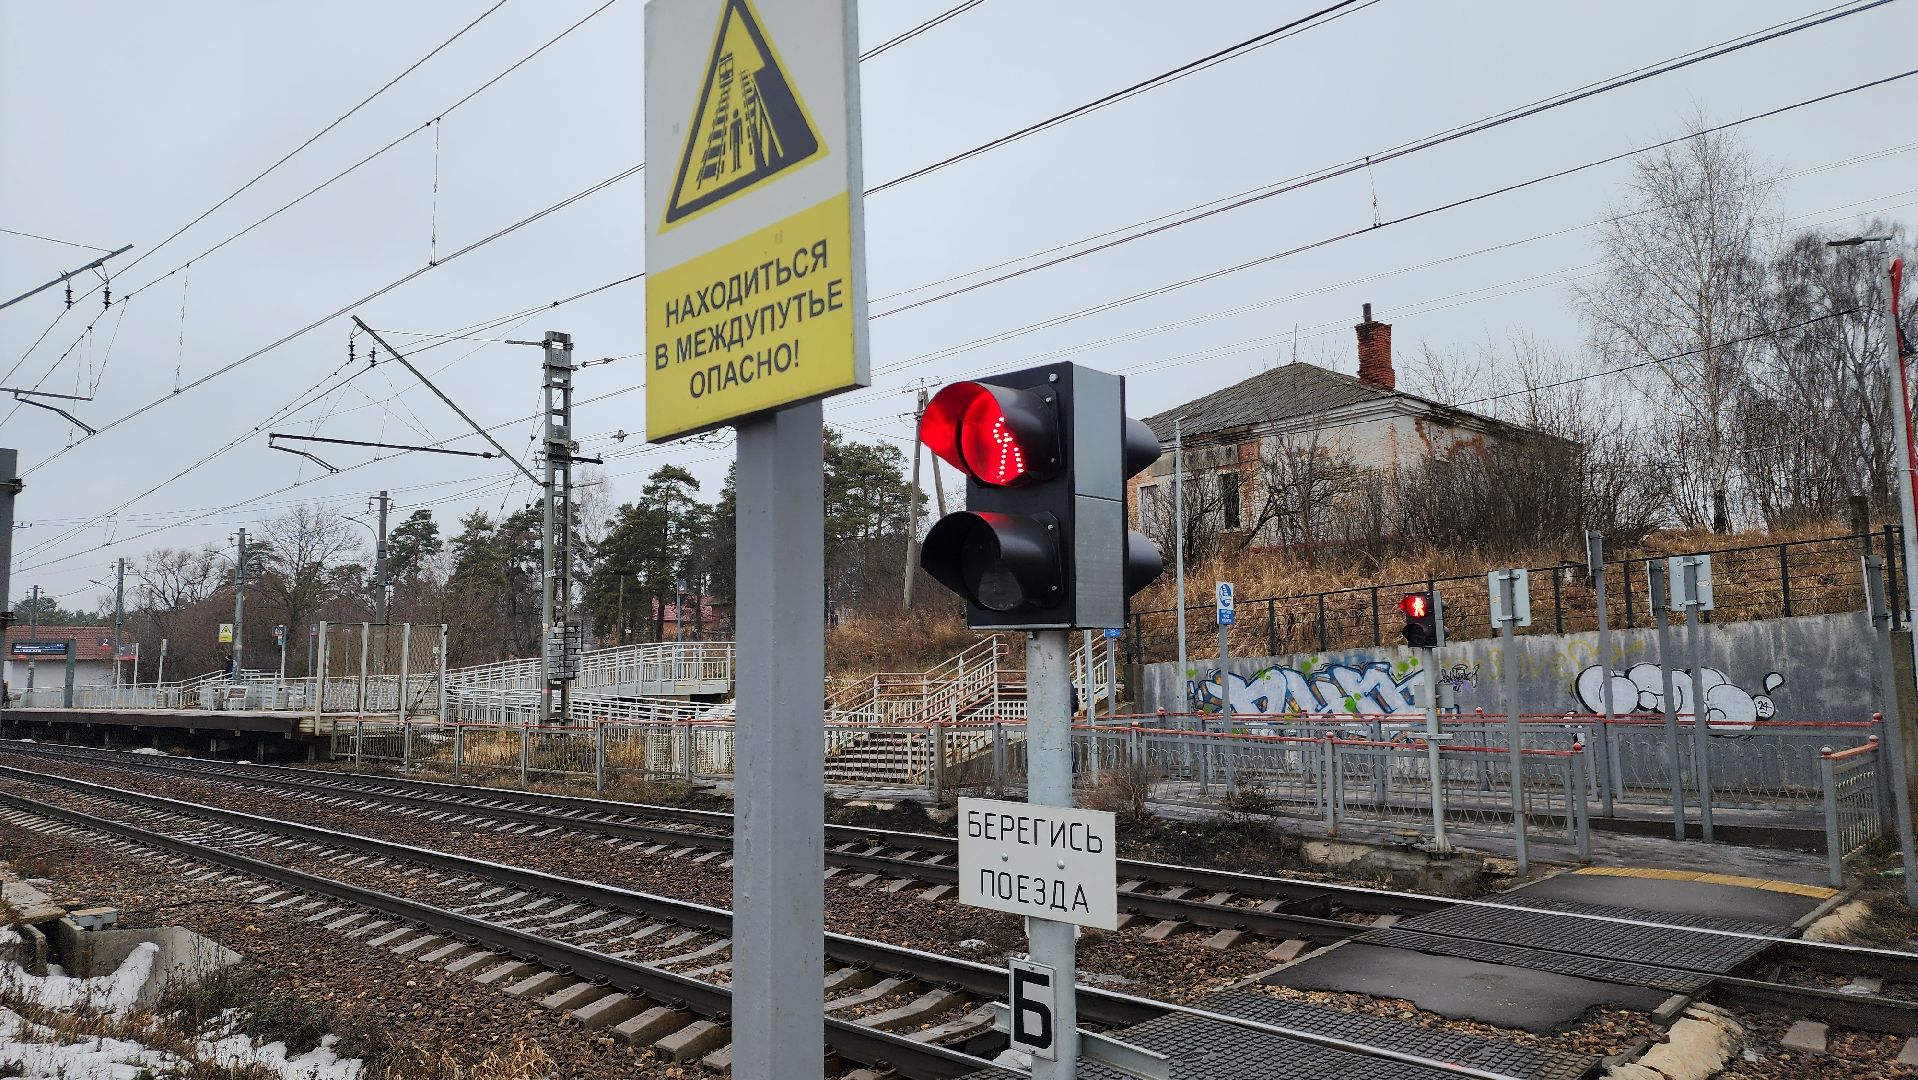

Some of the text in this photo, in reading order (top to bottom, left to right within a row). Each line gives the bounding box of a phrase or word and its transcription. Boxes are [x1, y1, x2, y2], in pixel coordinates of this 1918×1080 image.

[665, 238, 829, 328] НАХОДИТЬСЯ
[655, 279, 844, 371] В МЕЖДУПУТЬЕ
[689, 338, 801, 399] ОПАСНО!
[968, 810, 1103, 854] БЕРЕГИСЬ
[980, 868, 1090, 914] ПОЕЗДА
[1013, 967, 1053, 1050] Б
